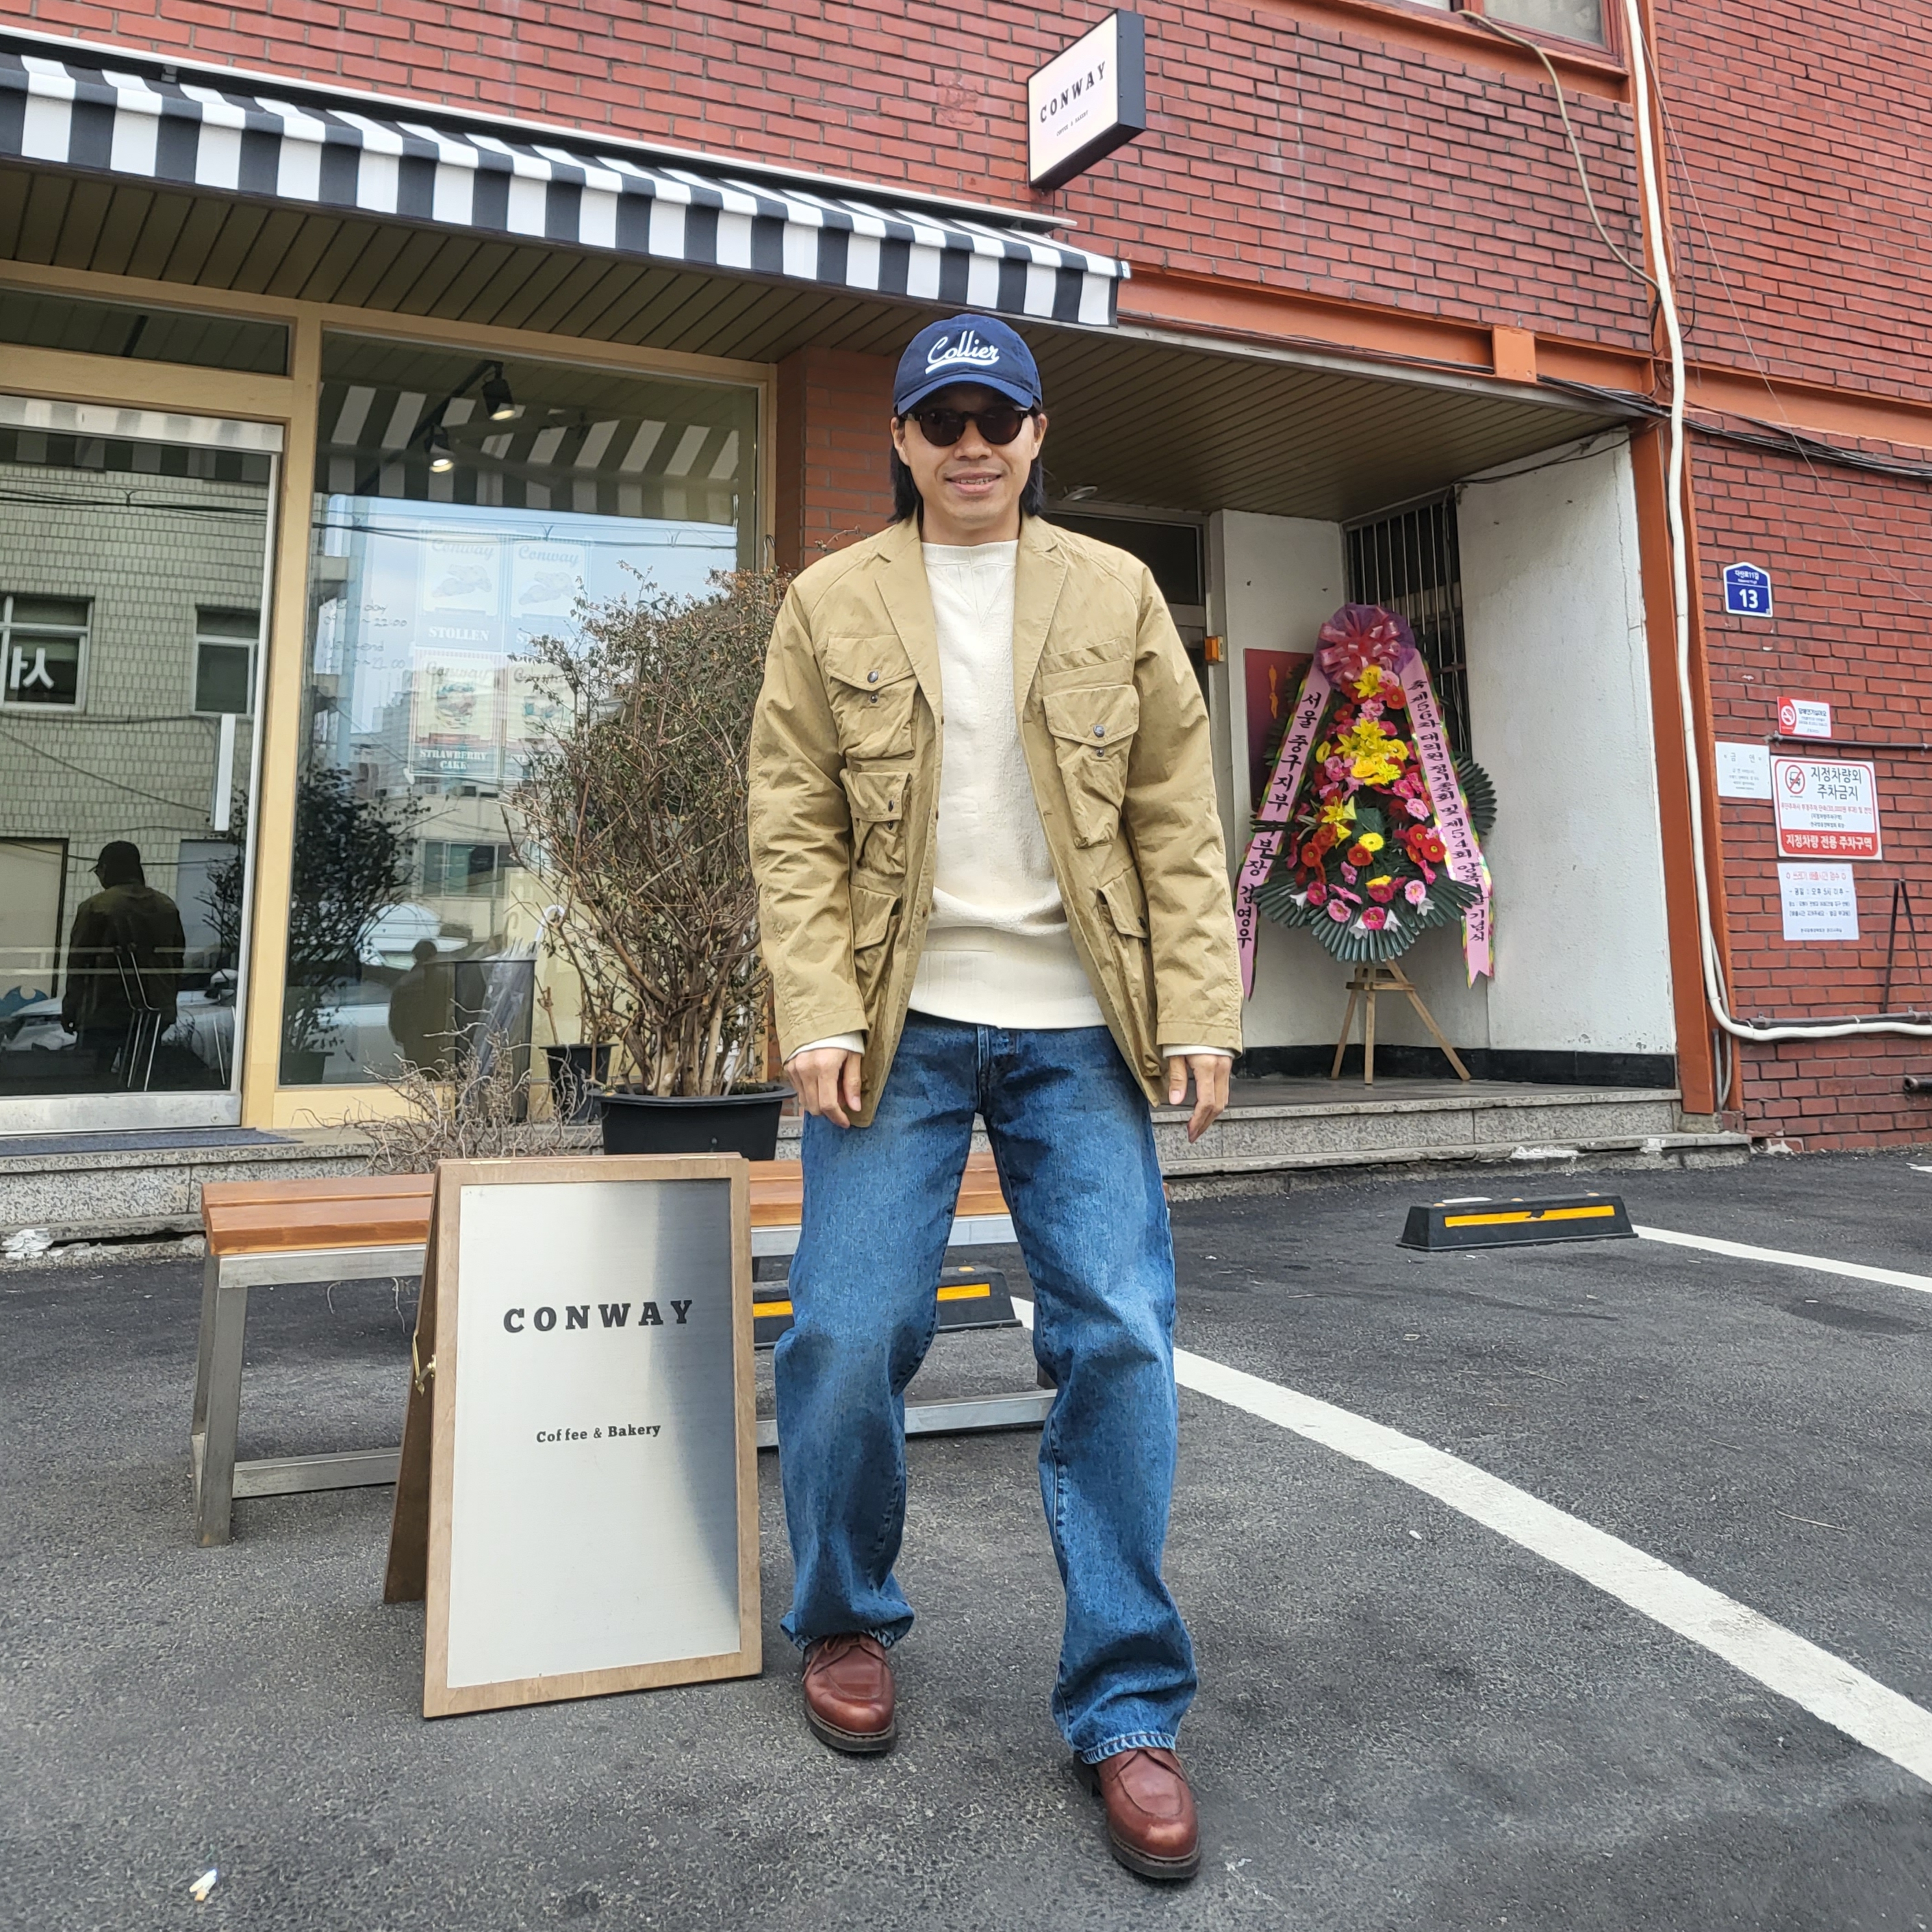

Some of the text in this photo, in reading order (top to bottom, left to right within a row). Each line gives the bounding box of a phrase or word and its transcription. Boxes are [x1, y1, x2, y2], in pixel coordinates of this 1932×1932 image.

[1039, 60, 1106, 124] CONWAY
[926, 329, 1000, 370] Collier
[431, 538, 495, 561] Conway
[518, 544, 580, 568] Conway
[1739, 588, 1758, 609] 13
[428, 626, 490, 642] STOLLEN
[1407, 679, 1427, 691] 축
[1296, 691, 1322, 728] 서울
[1410, 691, 1440, 728] 제56차
[420, 748, 487, 761] STRAWBERRY
[1419, 732, 1444, 761] 대의원
[440, 759, 468, 770] CAKE
[1267, 734, 1309, 812] 중구지부
[1810, 765, 1862, 785] 지정차량외
[1428, 763, 1455, 802] 정기총회
[1817, 784, 1859, 801] 주차금지
[1439, 804, 1460, 816] 및
[1443, 817, 1472, 859] 제54회
[1785, 834, 1872, 851] 지정차량 전용 주차구역
[1236, 883, 1257, 949] 김영우
[1469, 908, 1485, 942] 기념식
[503, 1299, 692, 1333] CONWAY
[536, 1424, 661, 1442] Coffee & Bakery
